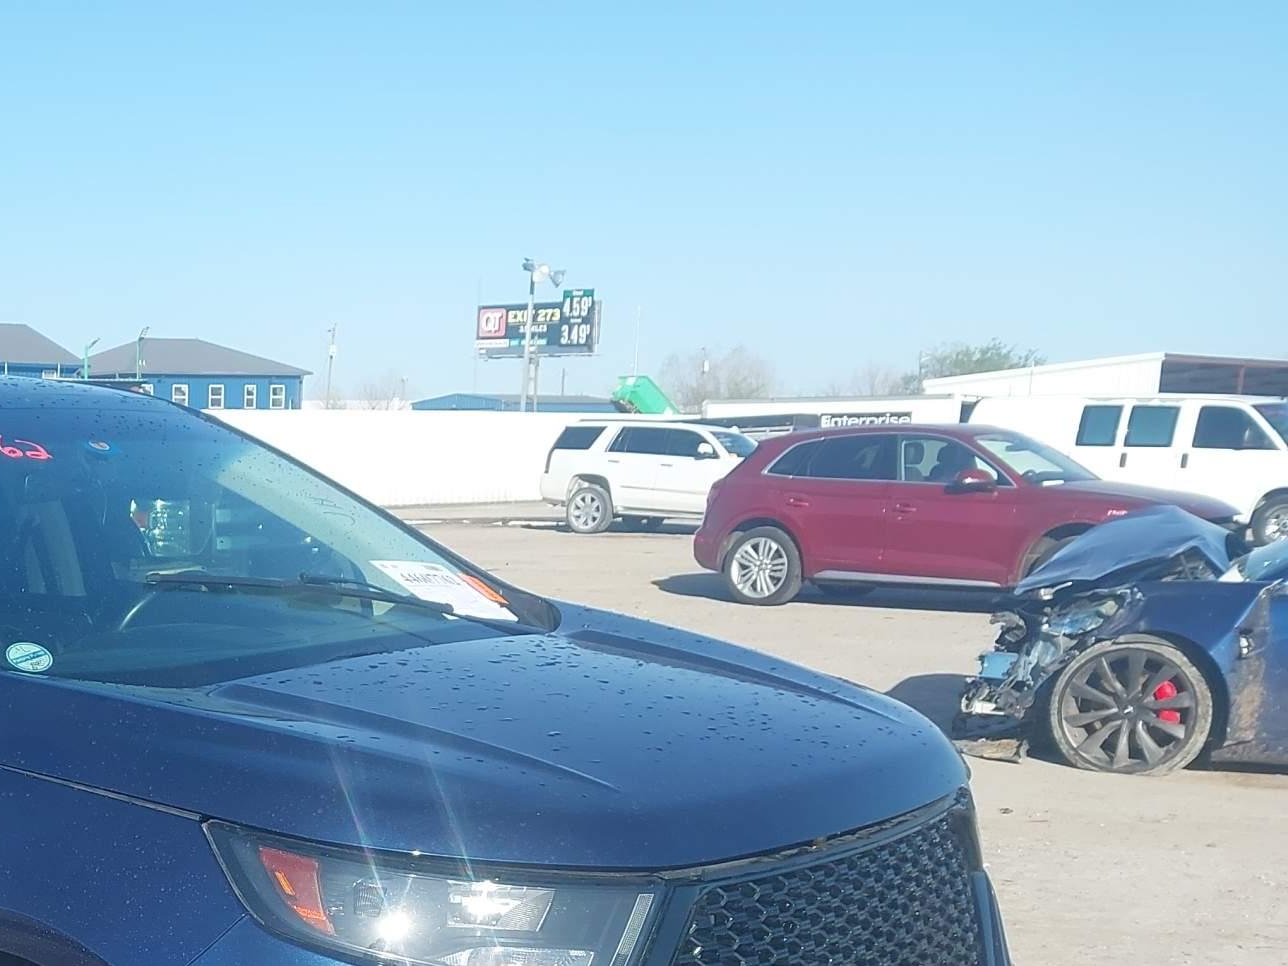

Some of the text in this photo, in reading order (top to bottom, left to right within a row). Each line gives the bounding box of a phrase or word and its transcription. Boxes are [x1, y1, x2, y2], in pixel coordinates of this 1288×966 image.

[481, 311, 503, 333] QT
[507, 309, 536, 323] EXI
[537, 308, 561, 322] 273
[820, 412, 912, 428] Enterprise
